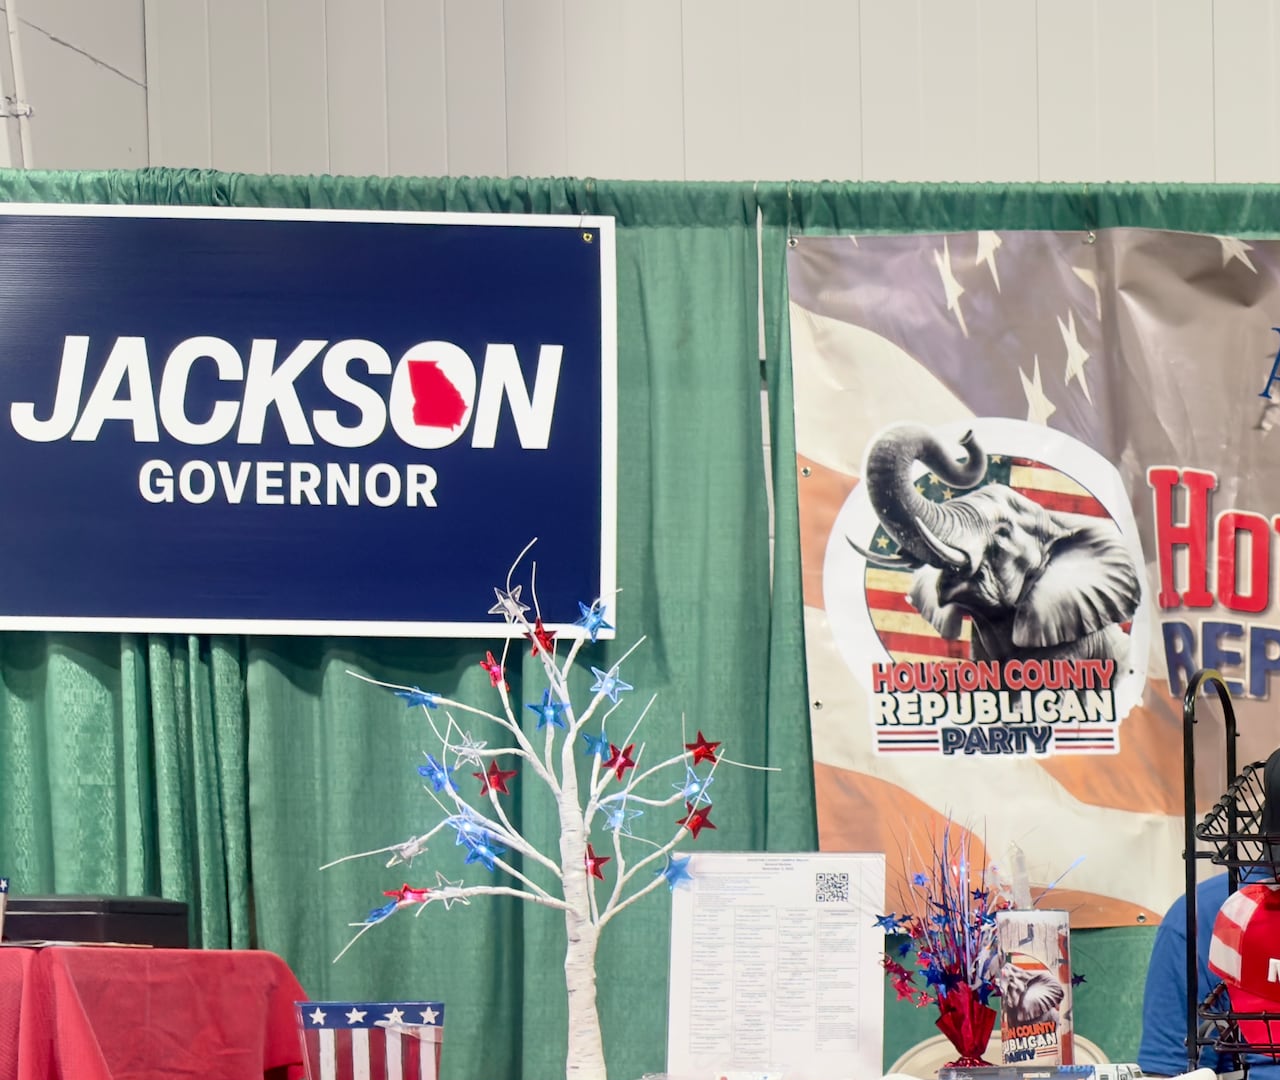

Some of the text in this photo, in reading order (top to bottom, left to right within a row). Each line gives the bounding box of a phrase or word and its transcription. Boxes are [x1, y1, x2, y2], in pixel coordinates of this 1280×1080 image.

[9, 335, 564, 450] JACKSON
[139, 459, 438, 508] GOVERNOR
[871, 658, 1115, 693] HOUSTON COUNTY
[876, 689, 1116, 726] REPUBLICAN
[942, 726, 1052, 755] PARTY
[1016, 1021, 1056, 1038] COUNTY
